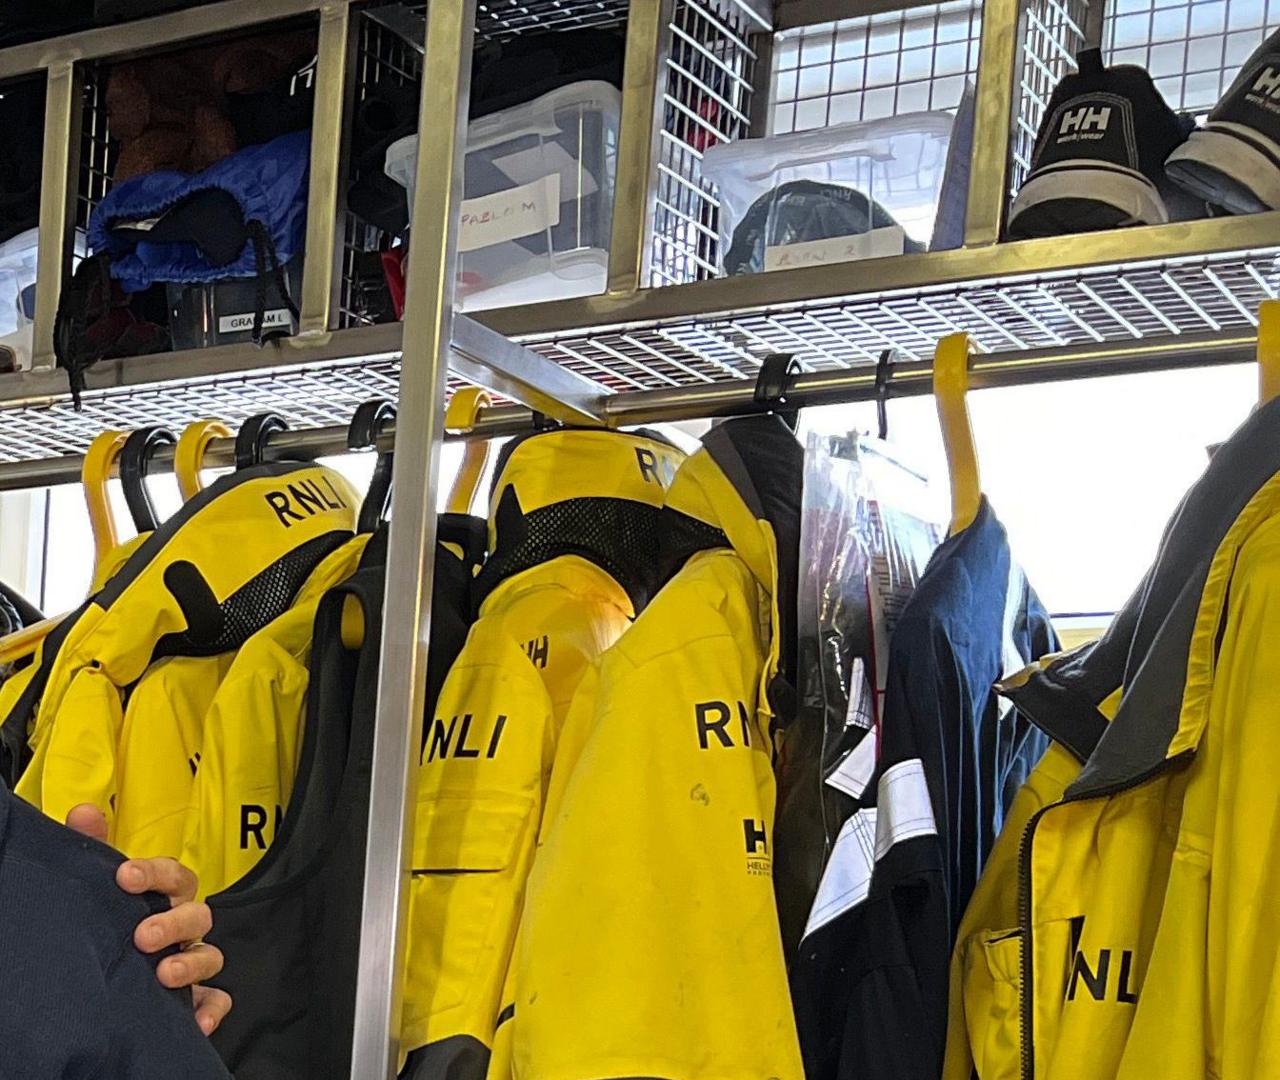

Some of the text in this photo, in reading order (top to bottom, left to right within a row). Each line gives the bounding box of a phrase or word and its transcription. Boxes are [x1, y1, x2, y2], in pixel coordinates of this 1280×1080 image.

[1059, 107, 1111, 134] HH
[264, 475, 347, 528] RNLI
[420, 714, 507, 766] NLI
[743, 818, 767, 854] H
